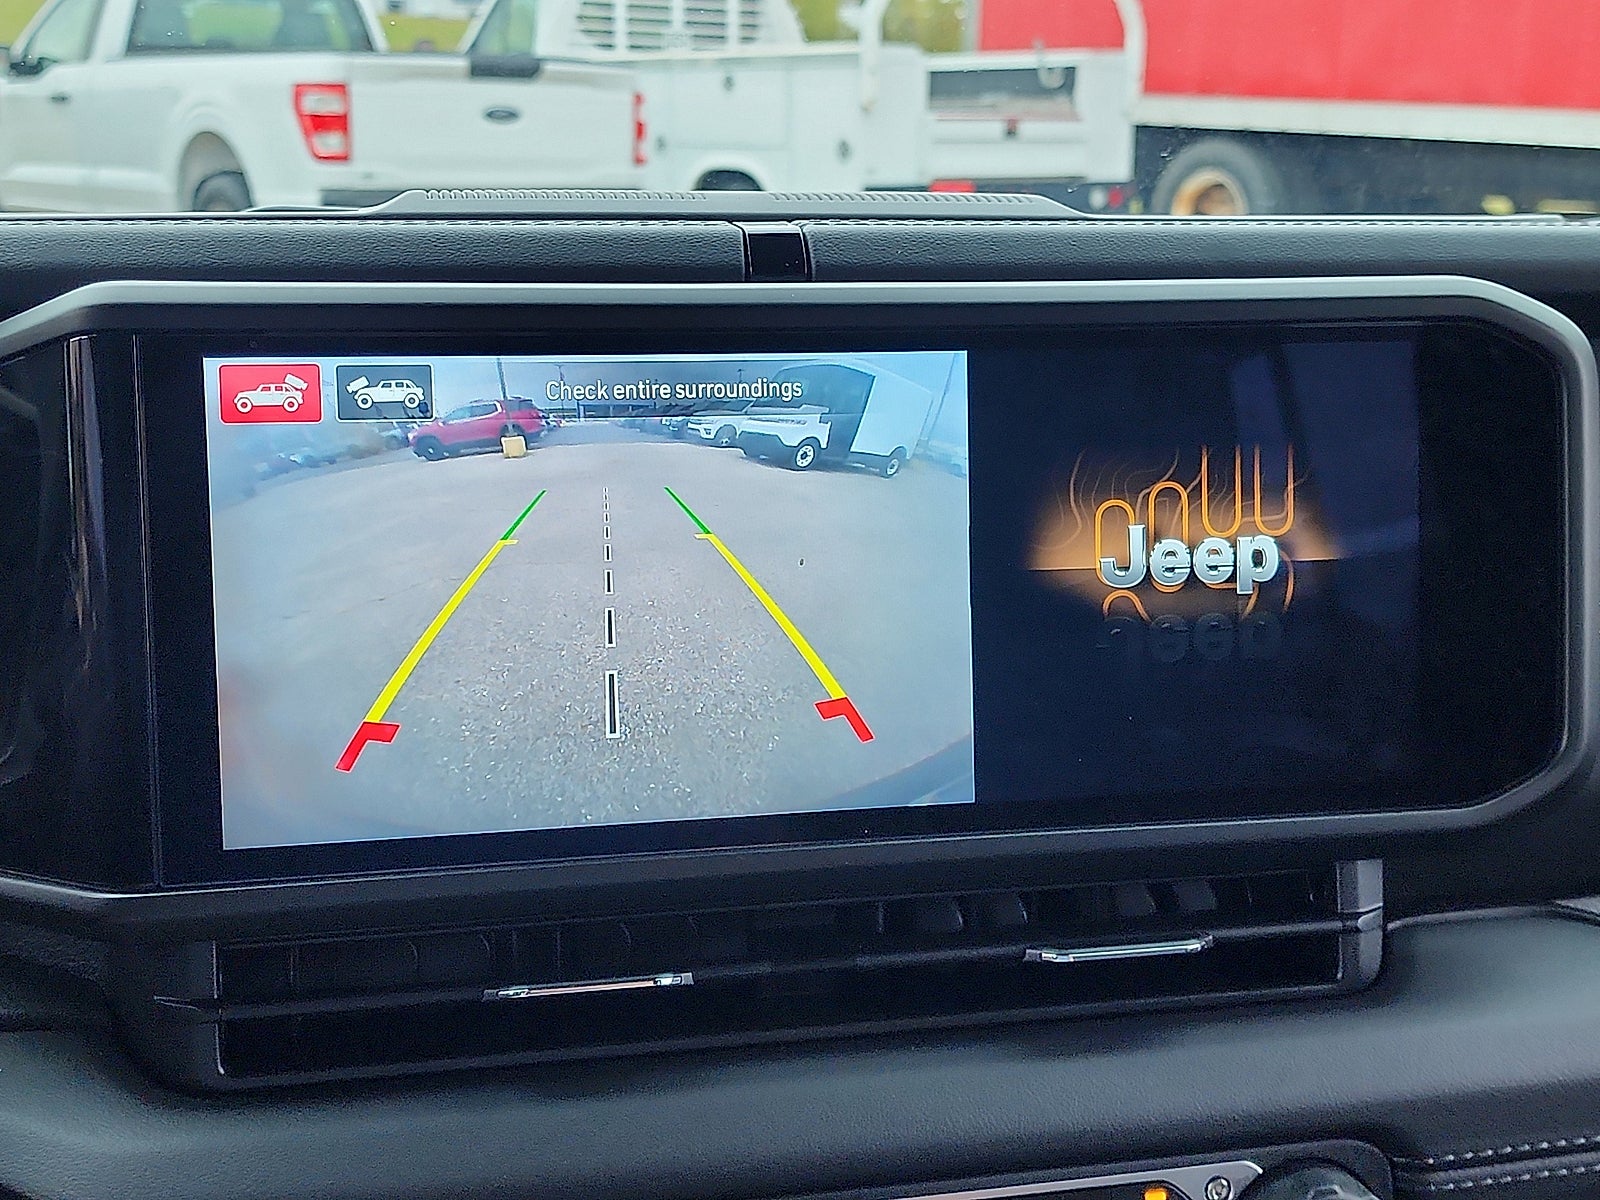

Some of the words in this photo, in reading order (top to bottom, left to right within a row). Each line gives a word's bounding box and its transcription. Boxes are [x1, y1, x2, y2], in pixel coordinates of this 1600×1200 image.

[546, 380, 609, 400] Check
[613, 380, 673, 399] entire
[676, 378, 803, 401] surroundings
[1099, 524, 1280, 594] Jeep
